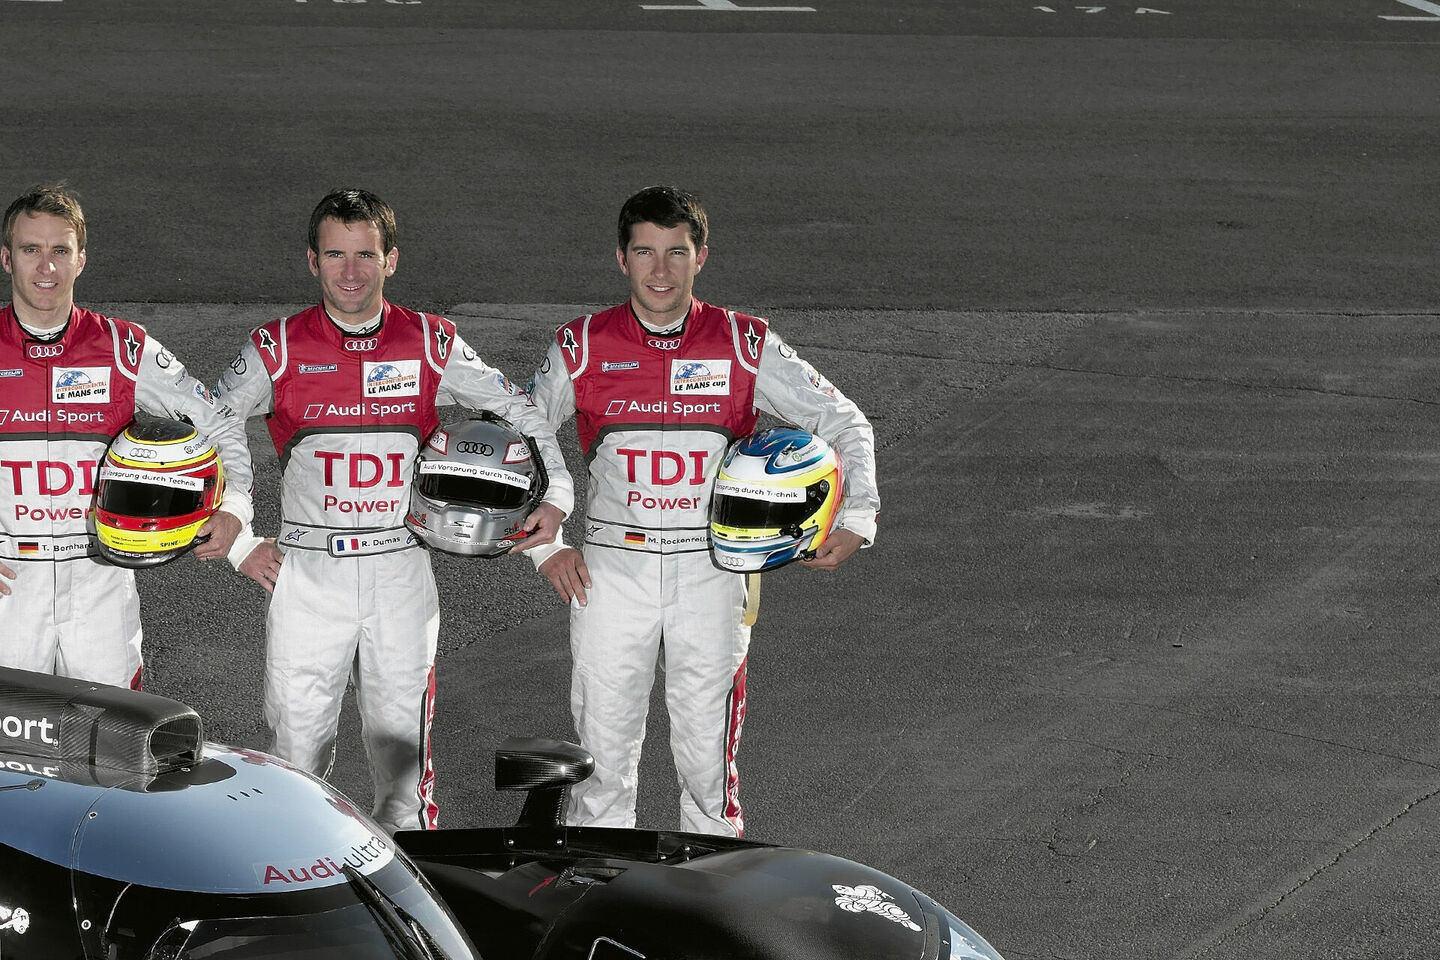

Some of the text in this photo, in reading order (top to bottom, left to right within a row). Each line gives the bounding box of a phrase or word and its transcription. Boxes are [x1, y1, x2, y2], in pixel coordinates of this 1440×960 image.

[67, 388, 91, 399] MANS
[93, 388, 106, 396] cup
[368, 381, 416, 395] LE MANS cup
[685, 381, 710, 391] MANS
[325, 401, 416, 417] Audi Sport
[627, 400, 721, 417] Audi Sport
[11, 410, 104, 425] Audi Sport
[314, 450, 405, 488] TDI
[437, 464, 478, 475] Vorsprung
[479, 469, 503, 479] durch
[616, 448, 709, 486] TDI
[0, 460, 97, 496] TDI
[141, 474, 166, 483] durch
[168, 477, 196, 488] Technik
[741, 486, 765, 496] durch
[324, 495, 400, 513] Power
[627, 491, 701, 510] Power
[15, 504, 95, 521] Power
[53, 542, 94, 552] Bernhard
[373, 537, 401, 546] Dumas
[263, 836, 387, 885] Audi ultra
